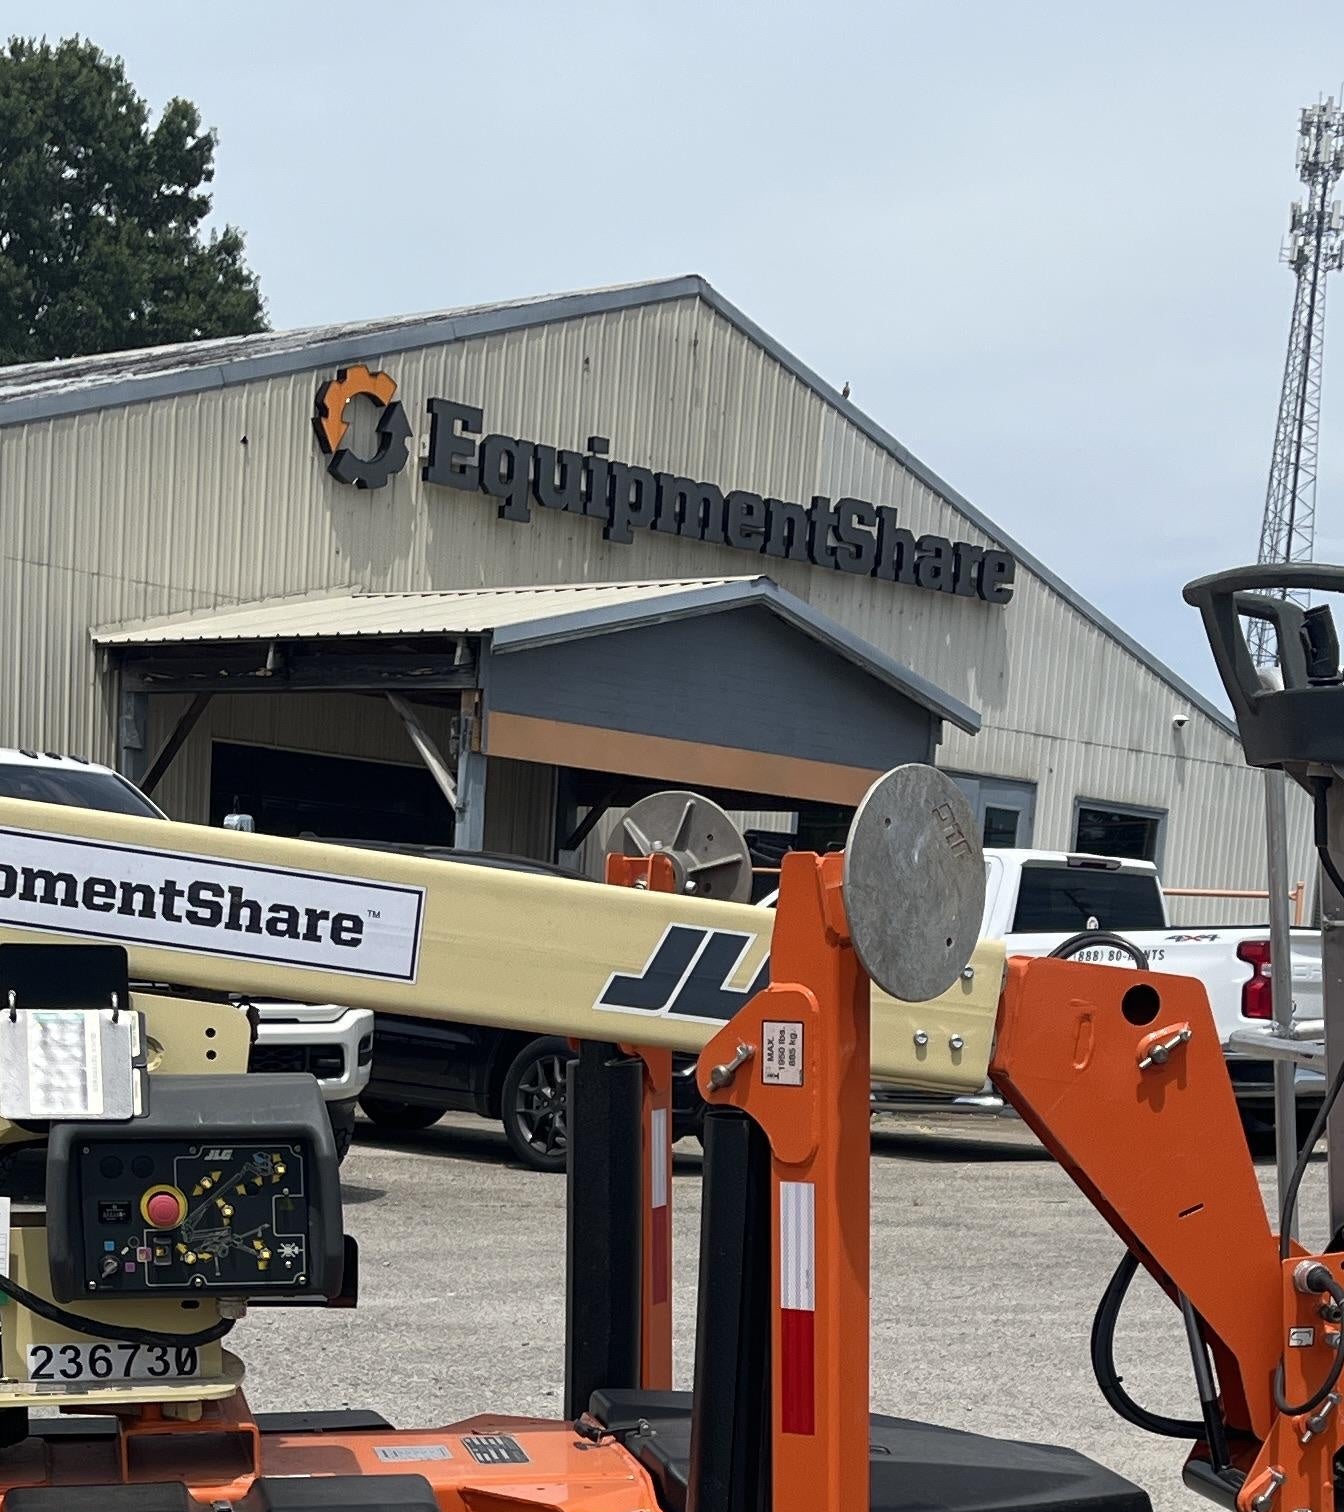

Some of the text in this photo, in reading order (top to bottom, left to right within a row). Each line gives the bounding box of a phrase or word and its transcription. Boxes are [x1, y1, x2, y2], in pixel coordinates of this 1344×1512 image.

[422, 397, 1017, 605] EquipmentShare
[596, 922, 771, 1026] JL
[1073, 949, 1165, 963] (888) 80-NTS
[778, 1047, 786, 1070] 1950
[30, 1344, 198, 1380] 236730
